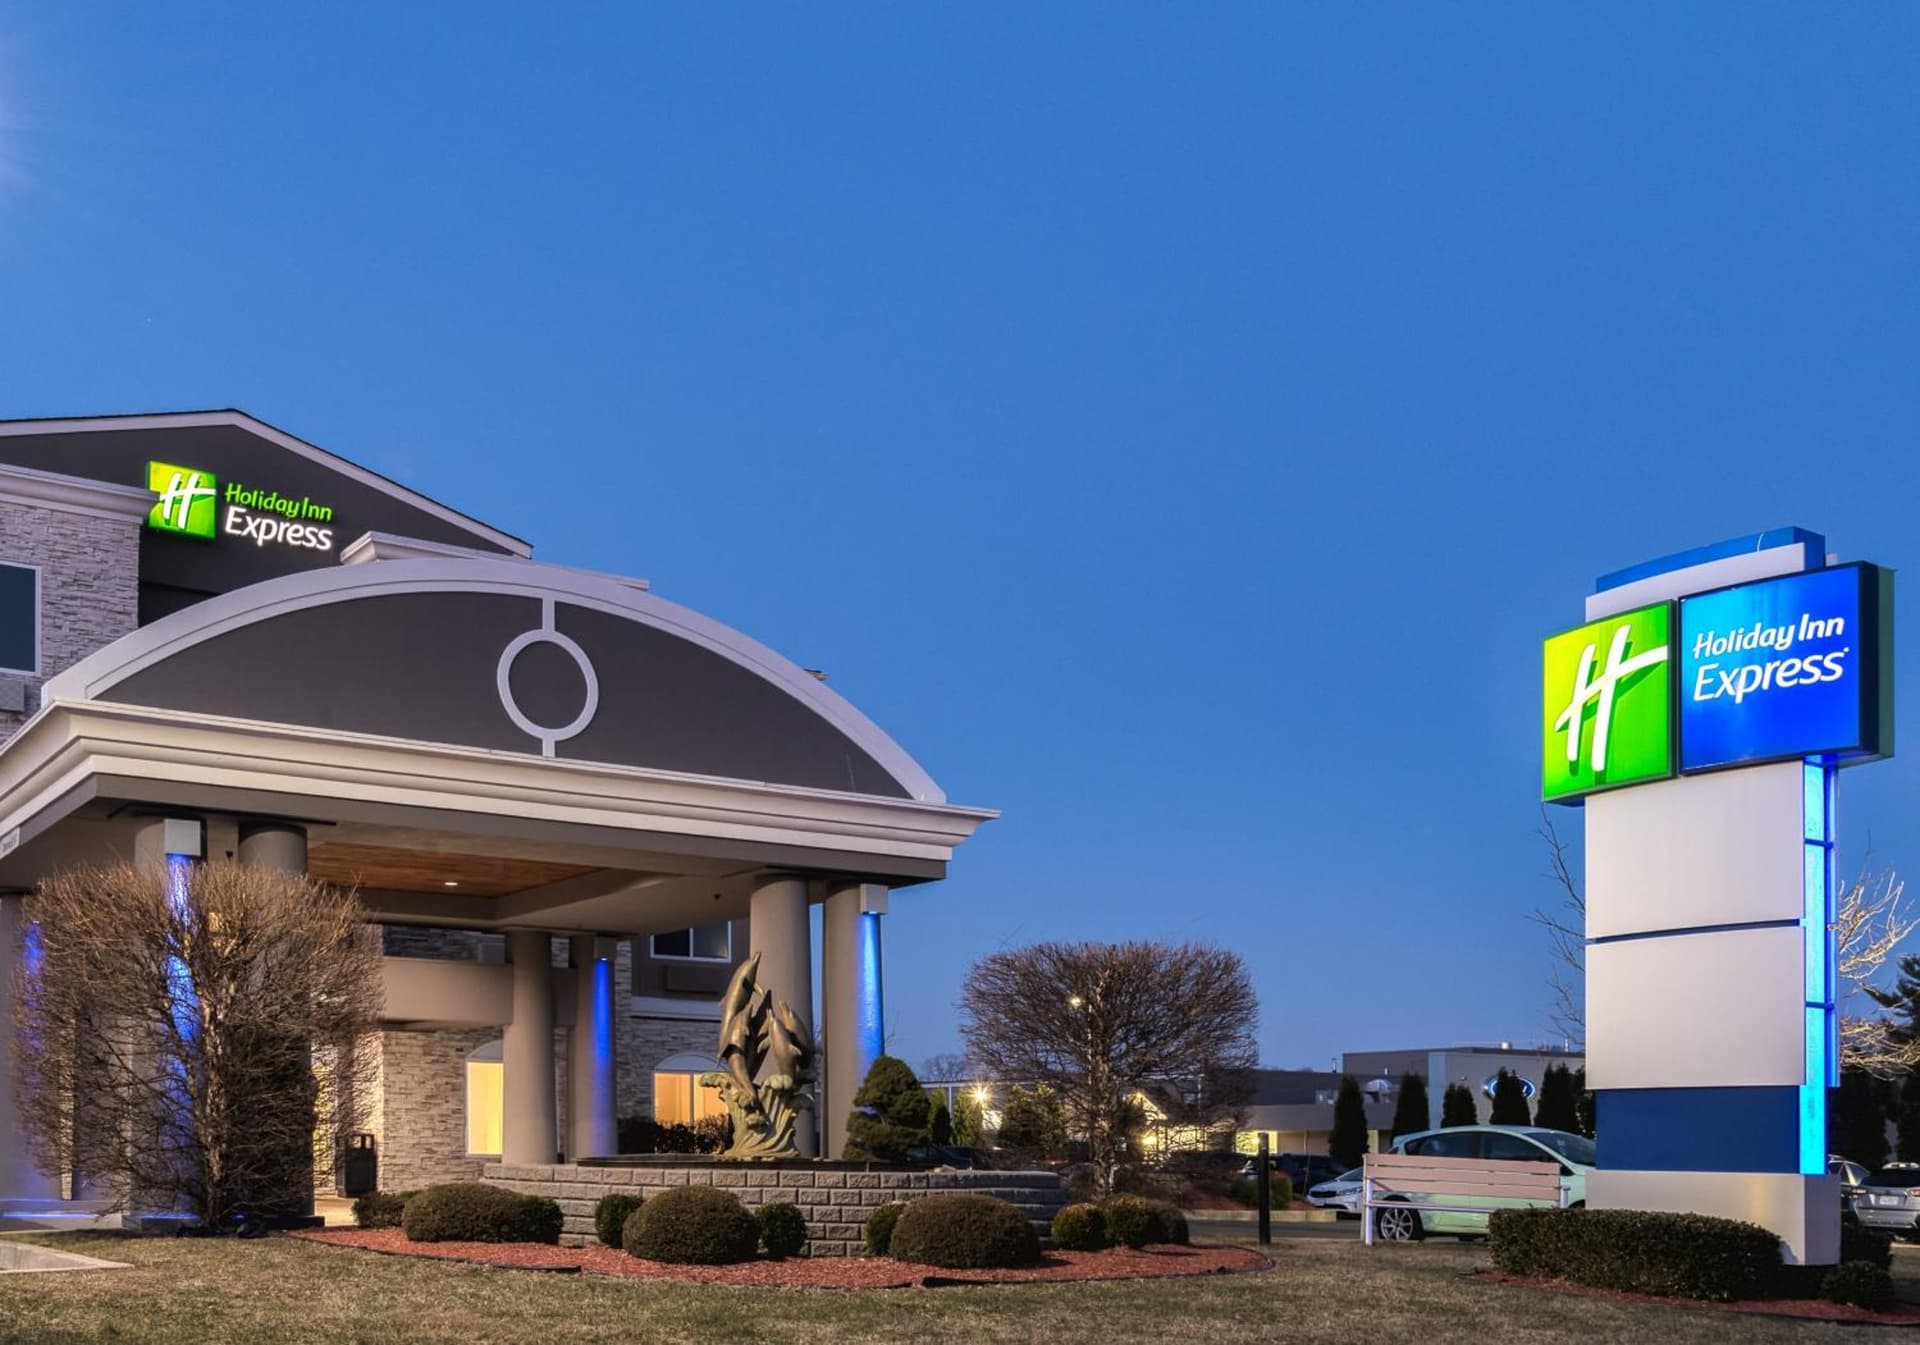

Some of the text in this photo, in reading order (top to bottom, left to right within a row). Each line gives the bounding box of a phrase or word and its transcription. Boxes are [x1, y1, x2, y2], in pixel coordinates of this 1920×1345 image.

[225, 483, 332, 521] Holiday Inn
[225, 505, 333, 550] Express
[1692, 613, 1845, 660] Holiday Inn
[1693, 651, 1845, 704] Express
